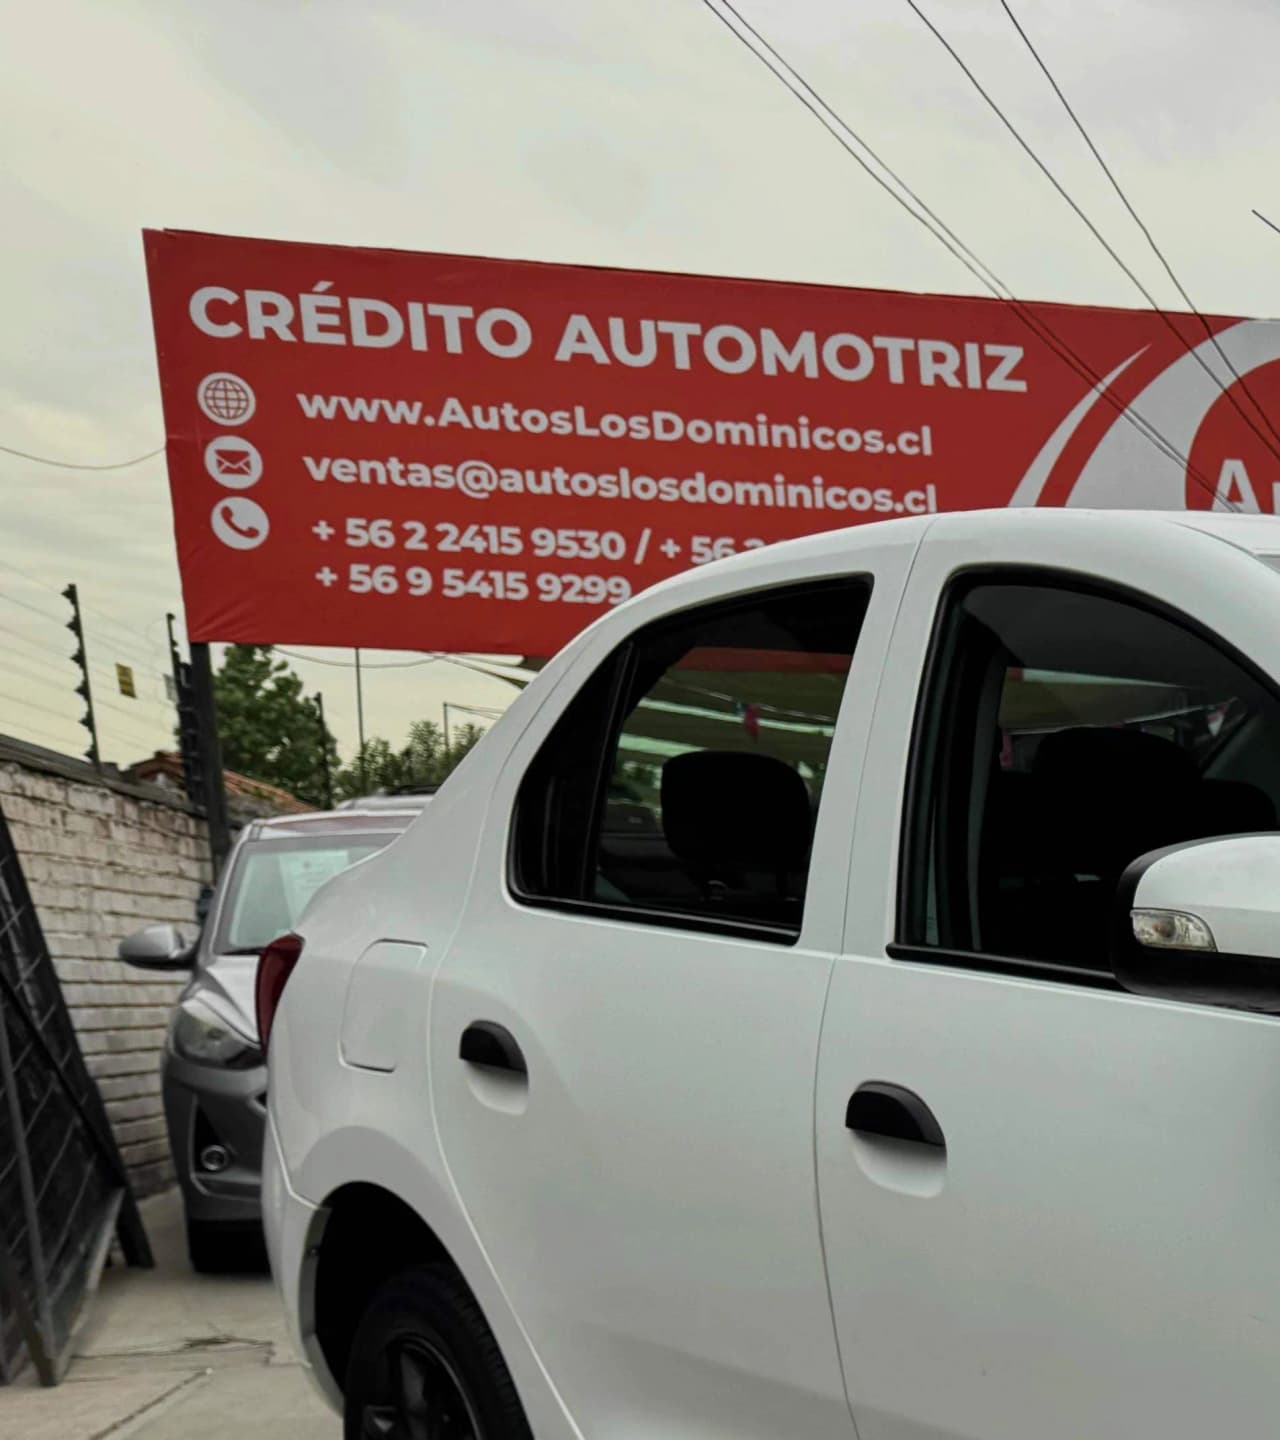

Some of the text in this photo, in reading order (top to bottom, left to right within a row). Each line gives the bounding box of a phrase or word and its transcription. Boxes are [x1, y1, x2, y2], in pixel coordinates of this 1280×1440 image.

[189, 280, 1028, 393] CRÉDITO AUTOMOTRIZ
[296, 391, 933, 457] www.AutosLosDominicos.cl
[302, 453, 937, 515] ventas@autoslosdominicos.cl
[345, 517, 396, 549] 56
[402, 520, 430, 551] 2
[435, 522, 524, 556] 2415
[531, 527, 627, 561] 9530
[690, 534, 736, 564] 56
[348, 563, 398, 594] 56
[405, 566, 433, 596] 9
[442, 568, 529, 601] 5415
[536, 572, 632, 606] 9299
